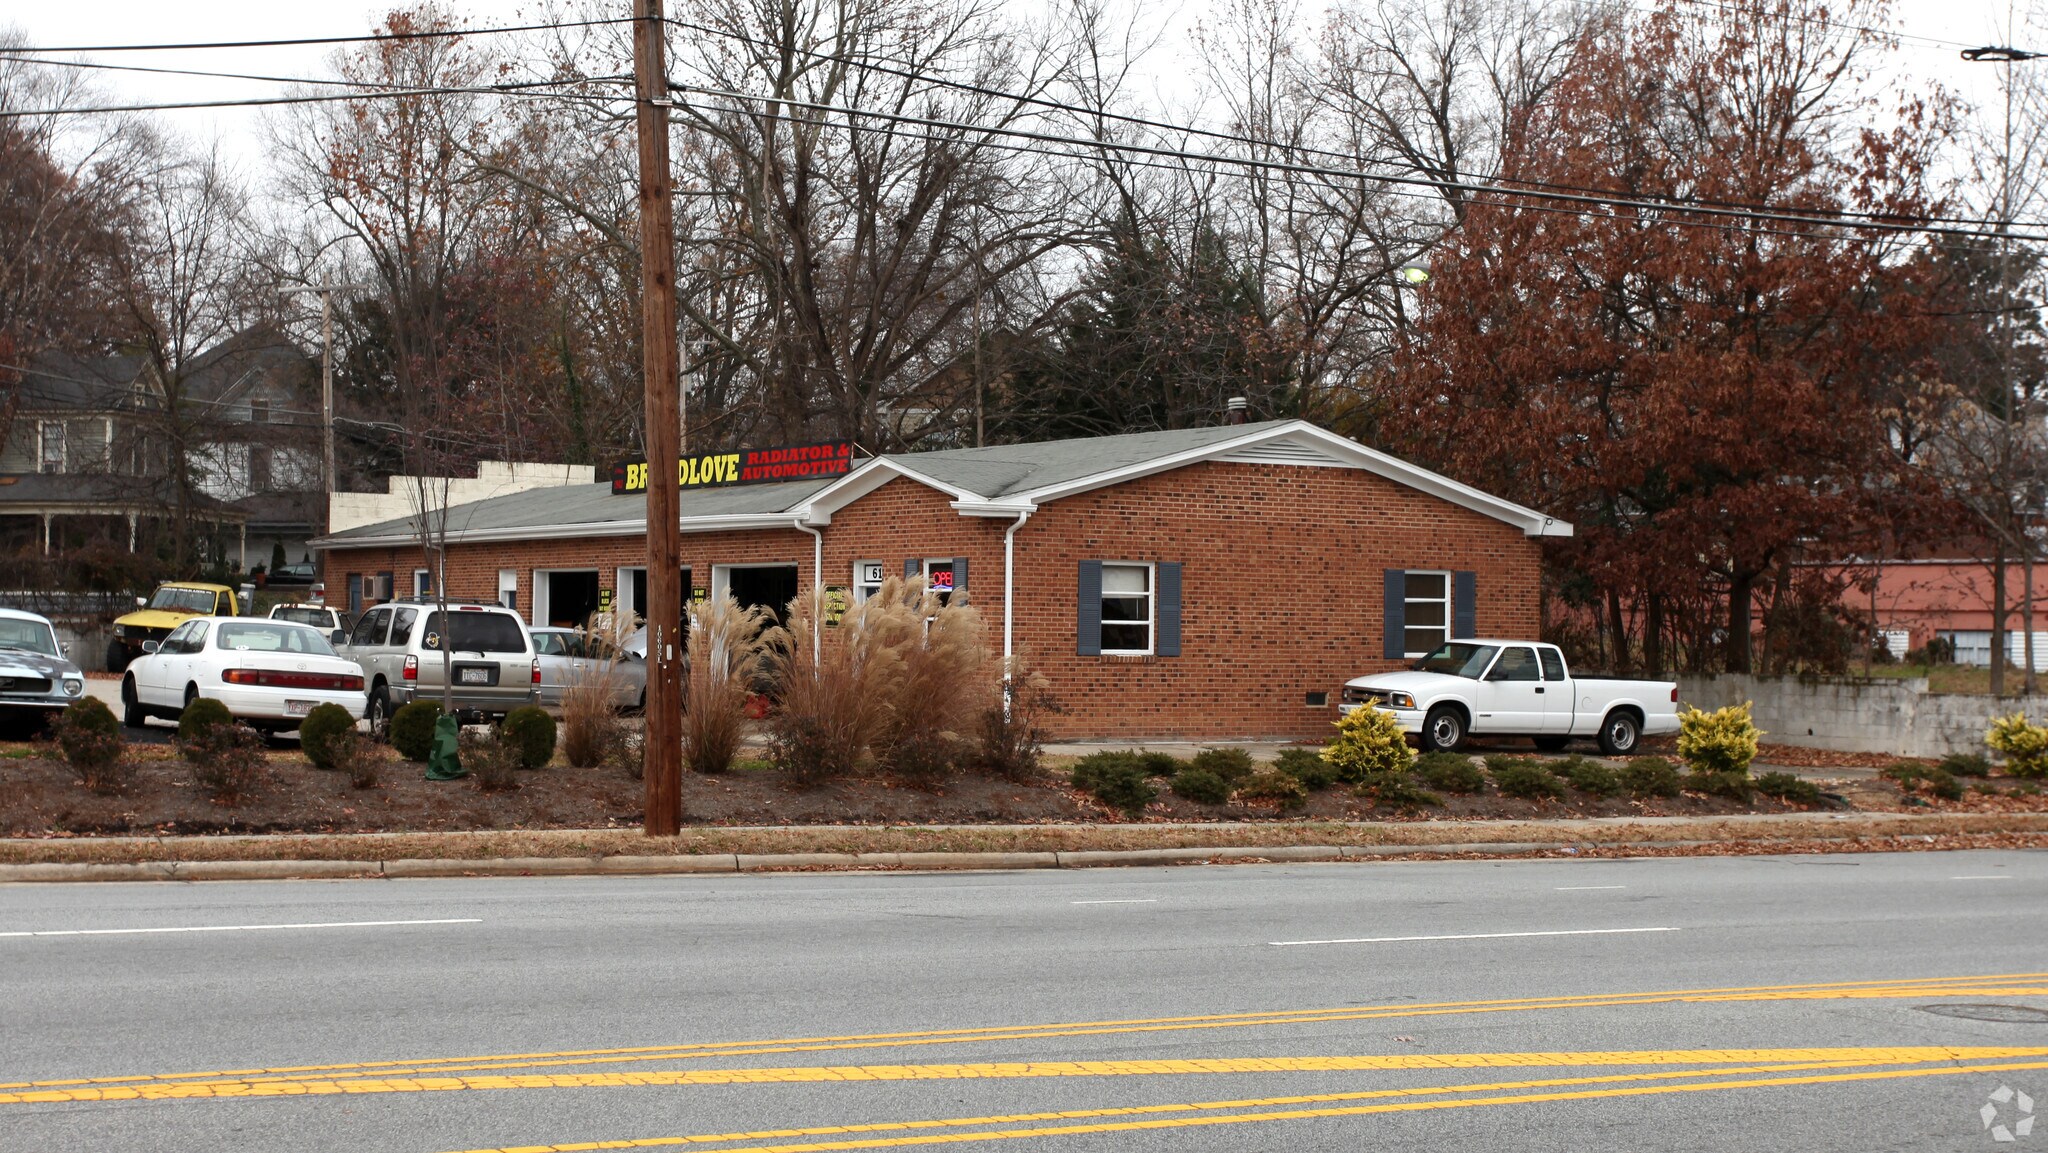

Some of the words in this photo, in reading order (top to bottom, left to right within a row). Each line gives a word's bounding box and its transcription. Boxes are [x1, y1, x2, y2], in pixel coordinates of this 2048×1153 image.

[747, 444, 834, 465] RADIATOR
[837, 443, 850, 458] &
[625, 453, 740, 490] BRDLOVE
[742, 459, 849, 481] AUTOMOTIVE
[933, 571, 953, 586] OPE
